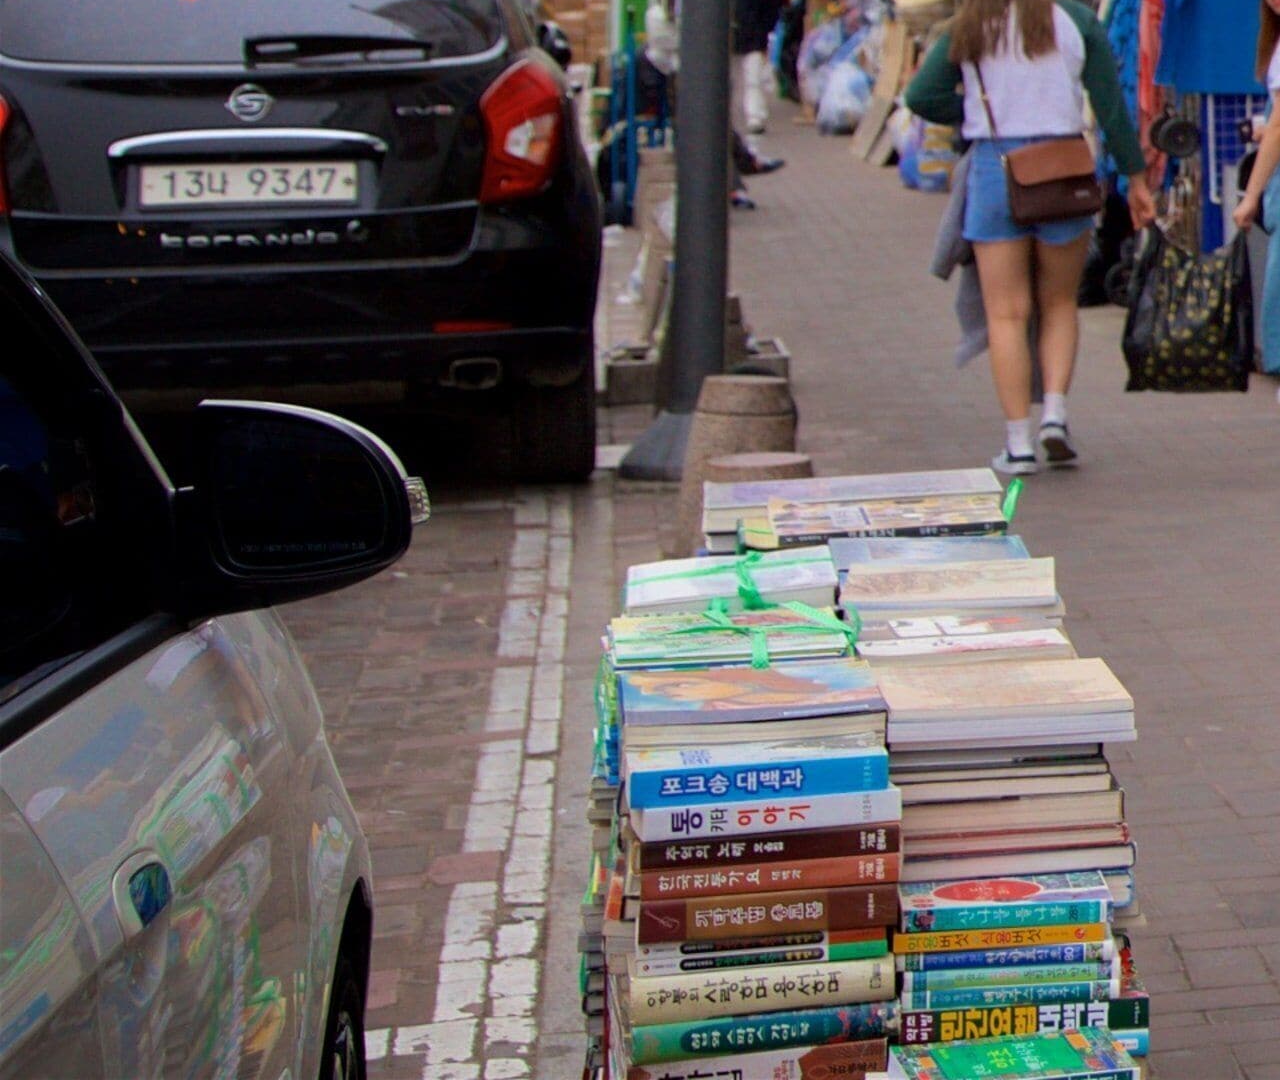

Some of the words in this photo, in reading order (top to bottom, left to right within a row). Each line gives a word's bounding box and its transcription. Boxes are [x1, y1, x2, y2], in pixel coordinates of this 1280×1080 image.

[248, 168, 336, 196] 9347
[661, 774, 730, 796] 포크송
[736, 768, 803, 792] 대백과
[671, 808, 704, 834] 통
[710, 808, 728, 832] 키타
[738, 805, 811, 827] 이야기
[666, 844, 711, 861] 추억의
[717, 842, 746, 858] 노래
[658, 869, 760, 891] 한국전통가요
[696, 906, 765, 928] 기타주법
[771, 900, 824, 922] 총교본
[907, 933, 969, 950] 약용버섯
[703, 977, 769, 1004] 사랑하며
[774, 970, 842, 997] 용서하며
[941, 1005, 1037, 1041] 민간요법
[1039, 1000, 1109, 1033] 대백과
